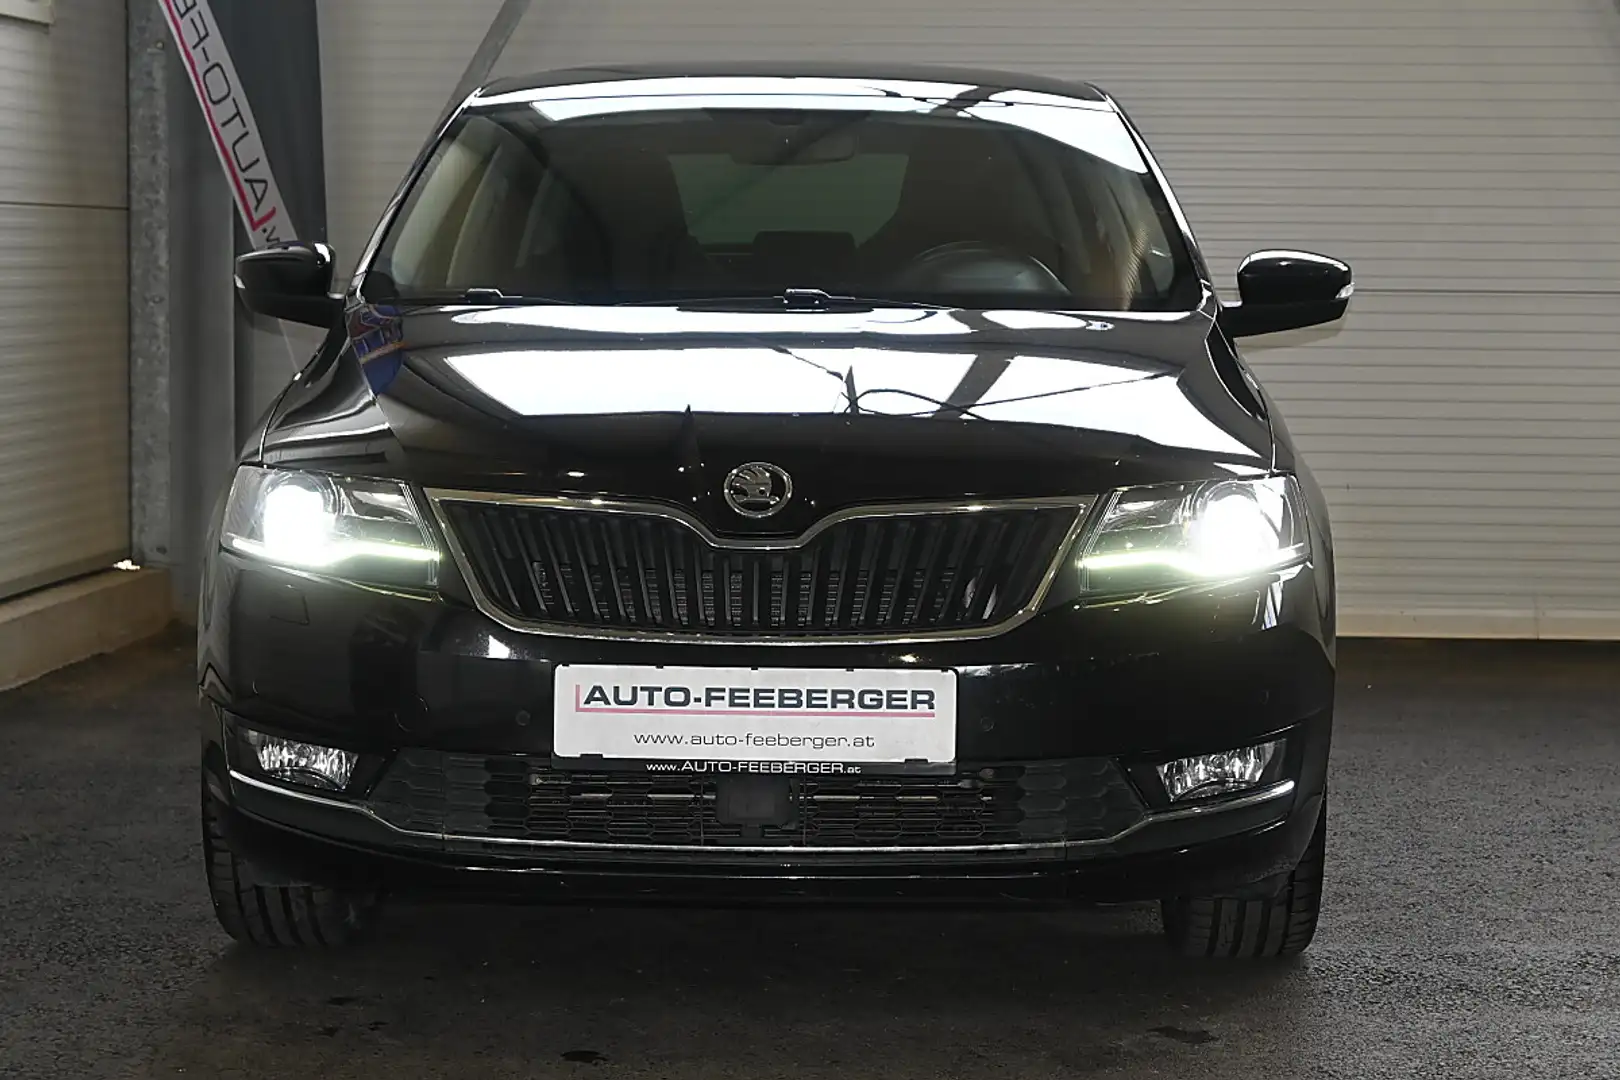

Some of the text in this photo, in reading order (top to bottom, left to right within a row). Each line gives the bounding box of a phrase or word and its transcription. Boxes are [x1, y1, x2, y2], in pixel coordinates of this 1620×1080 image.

[583, 685, 935, 710] AUTO-FEEBERGER
[633, 733, 875, 749] www.auto-feeberger.at
[646, 760, 862, 774] www.AUTO-FEEBERGER.at
